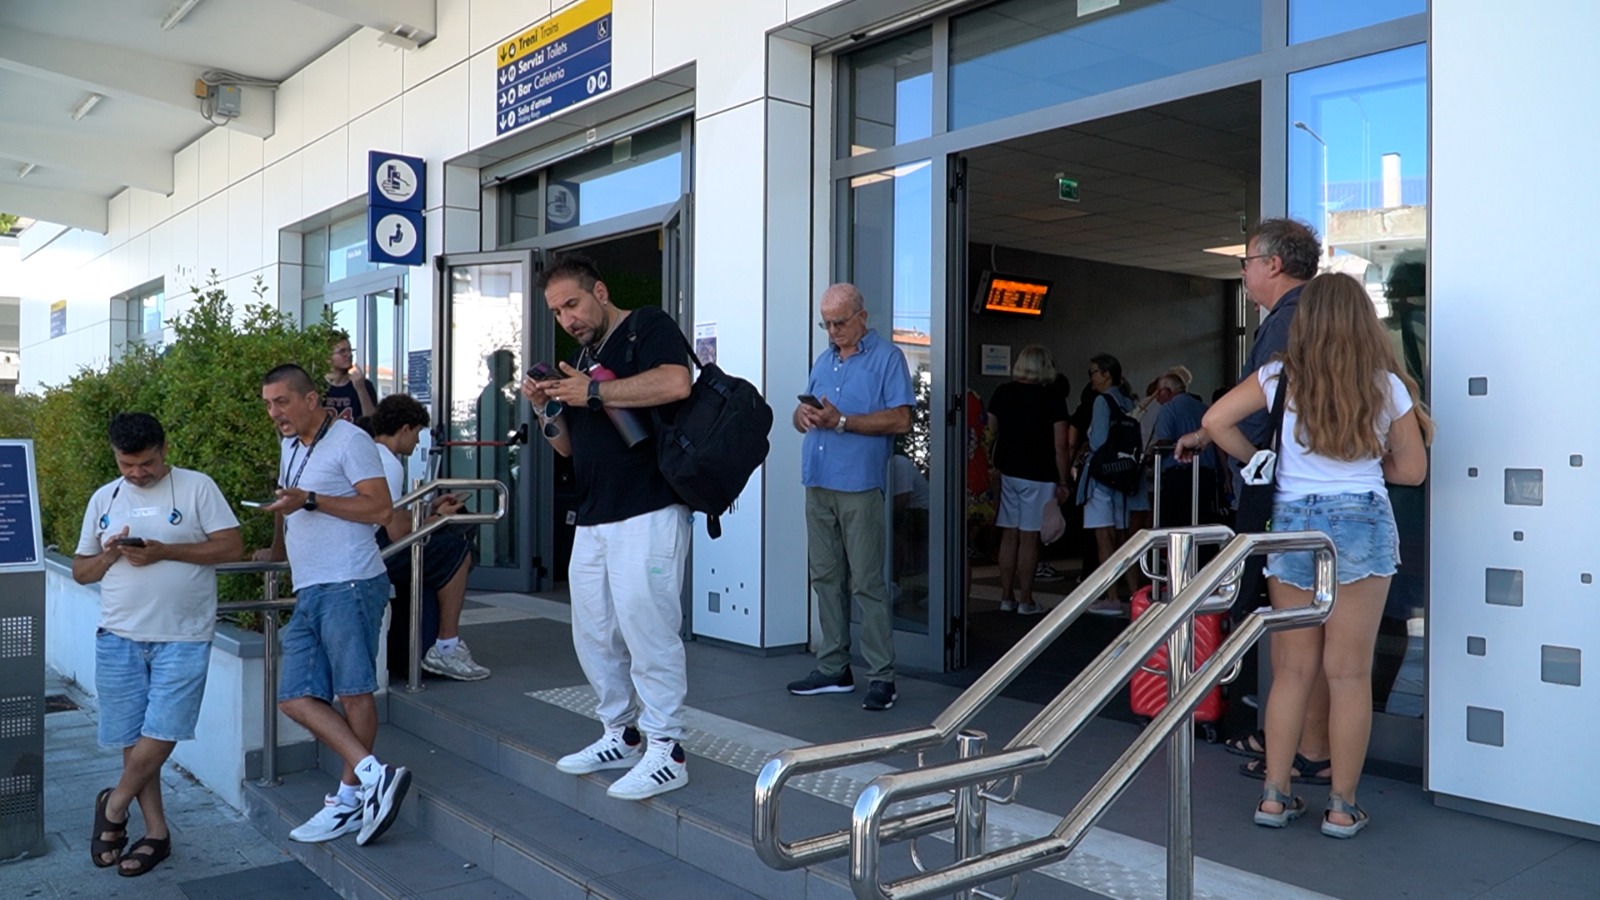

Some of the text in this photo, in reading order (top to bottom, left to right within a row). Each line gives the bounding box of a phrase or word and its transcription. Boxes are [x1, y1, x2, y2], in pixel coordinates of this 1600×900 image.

[519, 22, 560, 50] Treni Trains
[518, 41, 568, 74] Servizi Toilets
[518, 67, 565, 98] Bar Cafeteria
